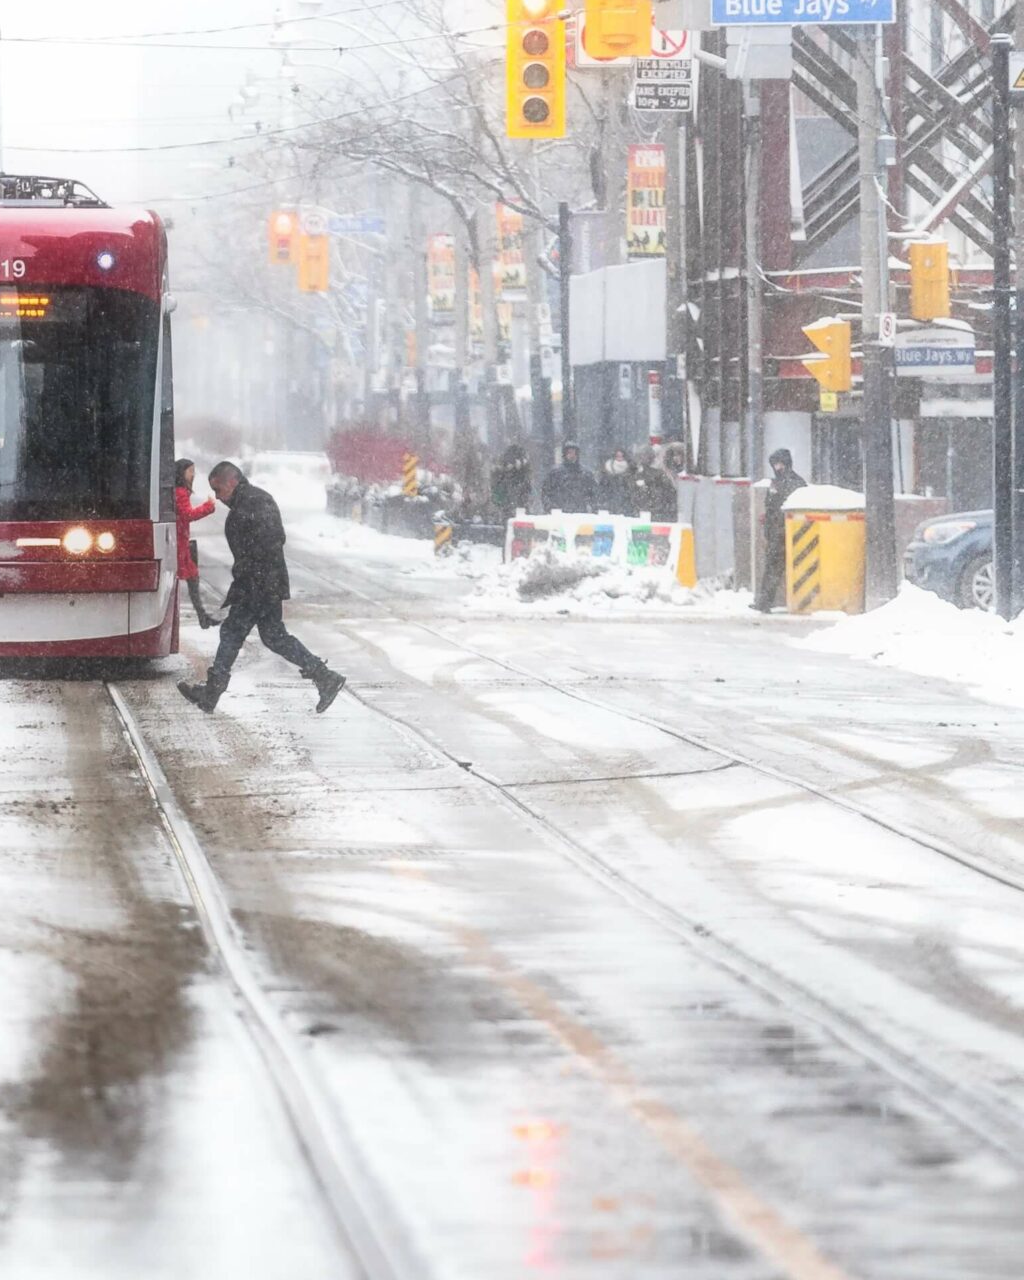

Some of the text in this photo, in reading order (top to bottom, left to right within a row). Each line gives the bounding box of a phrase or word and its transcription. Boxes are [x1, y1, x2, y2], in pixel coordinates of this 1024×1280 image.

[641, 70, 687, 79] EXCEPTED
[658, 87, 690, 96] EXCEPTED
[896, 349, 923, 362] Blue
